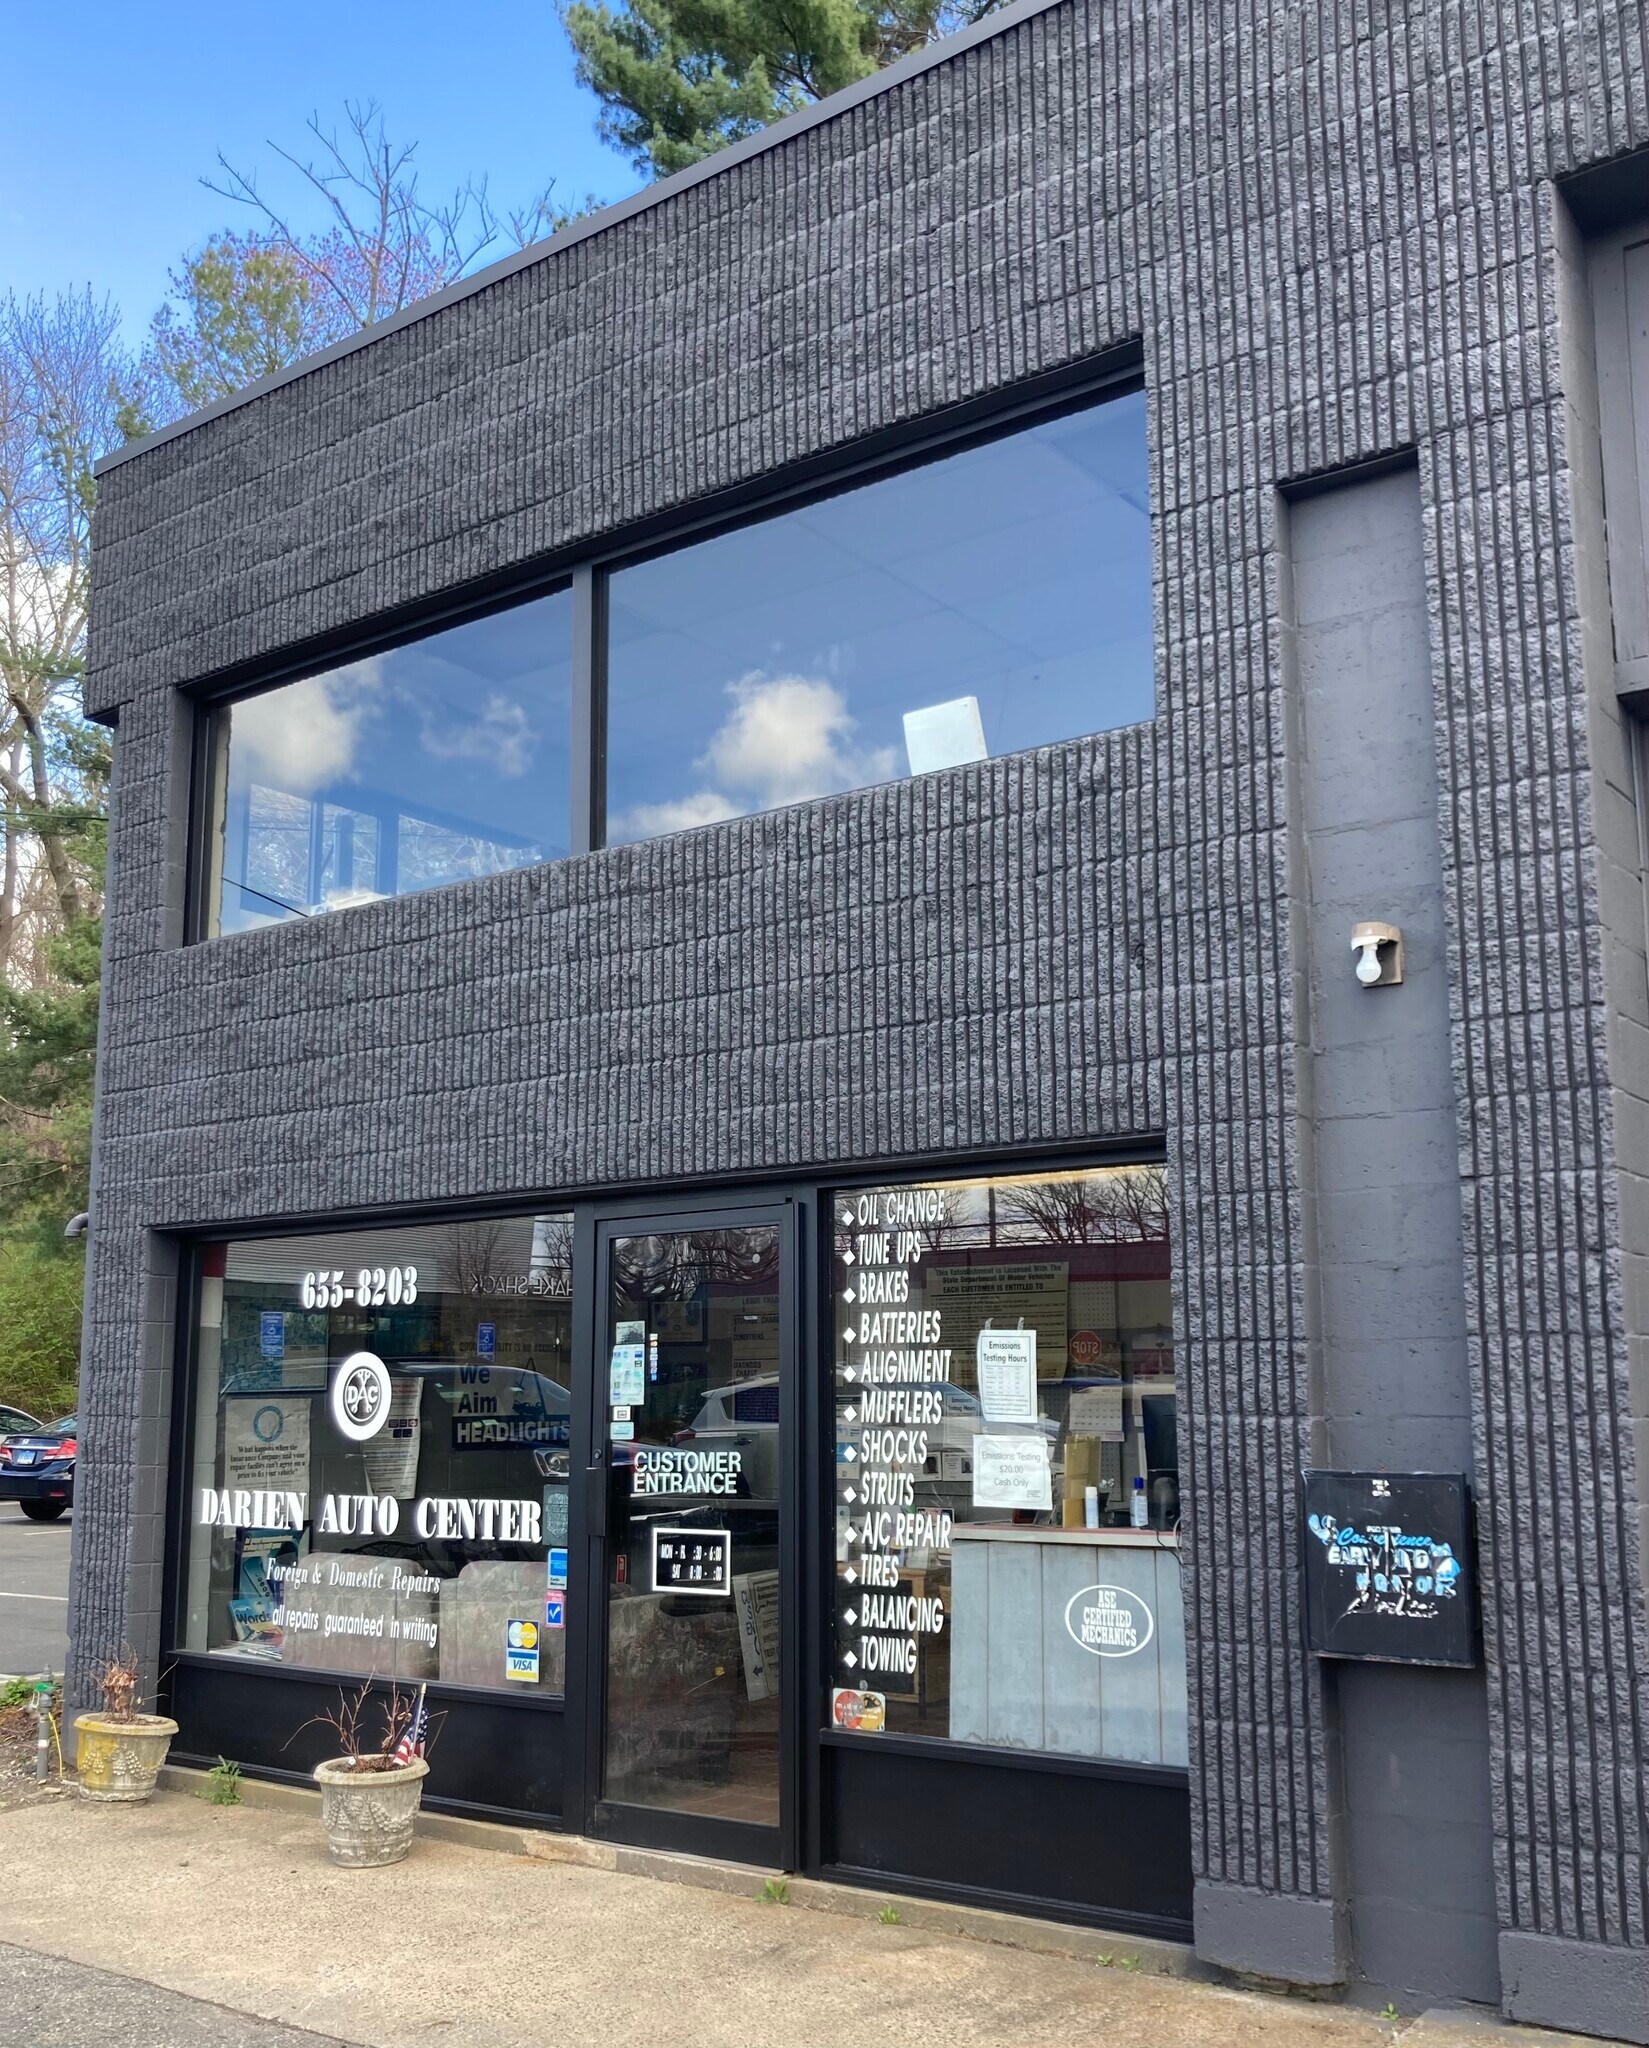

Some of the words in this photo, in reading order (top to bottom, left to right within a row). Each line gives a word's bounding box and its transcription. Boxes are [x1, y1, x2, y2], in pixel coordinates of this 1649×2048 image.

[858, 1194, 879, 1226] OIL
[886, 1189, 945, 1225] CHANGE
[859, 1232, 891, 1266] TUNE
[897, 1230, 921, 1264] UPS
[302, 1266, 418, 1309] 655-8203
[859, 1270, 909, 1304] BRAKES
[943, 1286, 960, 1294] EACH
[961, 1284, 996, 1293] CUSTOMER
[1005, 1283, 1034, 1291] ENTITLED
[961, 1275, 997, 1284] Department
[1007, 1273, 1026, 1281] Motor
[860, 1310, 942, 1344] BATTERIES
[988, 1341, 1022, 1350] Emissions
[860, 1349, 952, 1384] ALIGNMENT
[983, 1354, 1006, 1364] Testing
[1008, 1354, 1028, 1363] Hours
[459, 1366, 490, 1384] We
[458, 1392, 498, 1414] Aim
[860, 1390, 943, 1424] MUFFLERS
[457, 1420, 570, 1444] HEADLIGHTS
[860, 1430, 928, 1464] SHOCKS
[981, 1452, 1015, 1460] Emissions
[1016, 1453, 1041, 1463] Testing
[633, 1451, 742, 1473] CUSTOMER
[999, 1465, 1024, 1474] $20.00
[633, 1473, 738, 1494] ENTRANCE
[860, 1471, 915, 1505] STRUTS
[993, 1477, 1012, 1486] Cash
[1013, 1479, 1030, 1488] Only
[200, 1488, 308, 1531] DARIEN
[318, 1493, 400, 1536] AUTO
[416, 1497, 543, 1543] CENTER
[861, 1511, 892, 1551] A/C
[895, 1513, 952, 1548] REPAIR
[660, 1544, 674, 1559] MON
[265, 1557, 309, 1590] Foreign
[312, 1568, 322, 1585] &
[329, 1562, 384, 1589] Domestic
[391, 1566, 441, 1599] Repairs
[671, 1563, 681, 1579] SAT
[860, 1553, 900, 1588] TIRES
[1098, 1590, 1117, 1609] ASE
[861, 1593, 944, 1634] BALANCING
[1083, 1606, 1132, 1628] CERTIFIED
[272, 1604, 285, 1627] all
[286, 1608, 319, 1632] repairs
[325, 1612, 384, 1637] guaranteed
[390, 1616, 400, 1639] in
[403, 1617, 438, 1648] writing
[1081, 1624, 1137, 1647] MECHANICS
[512, 1659, 533, 1671] VISA
[861, 1635, 918, 1674] TOWING
